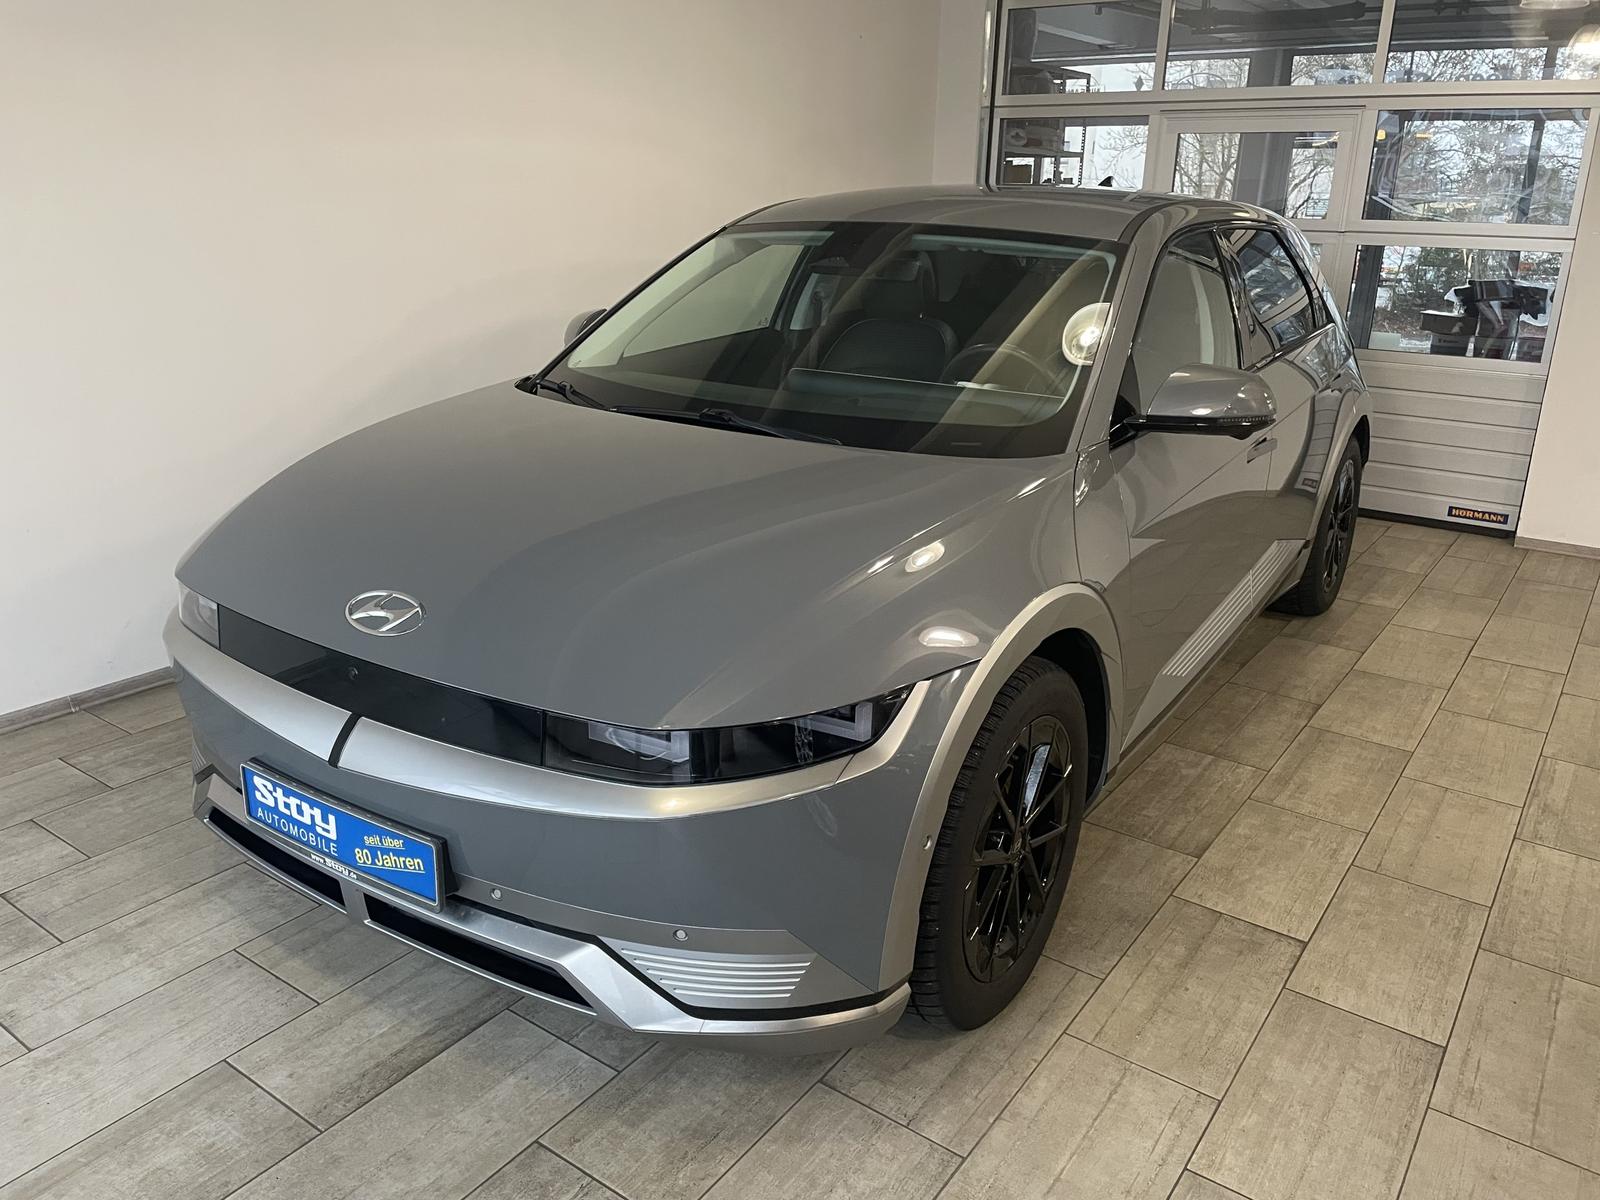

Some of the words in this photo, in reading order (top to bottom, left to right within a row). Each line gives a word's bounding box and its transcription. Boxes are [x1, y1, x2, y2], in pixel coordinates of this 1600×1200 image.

[257, 807, 338, 857] AUTOMOBILE
[363, 834, 381, 846] seit
[382, 835, 404, 848] über
[354, 847, 372, 865] 80
[374, 850, 424, 871] Jahren
